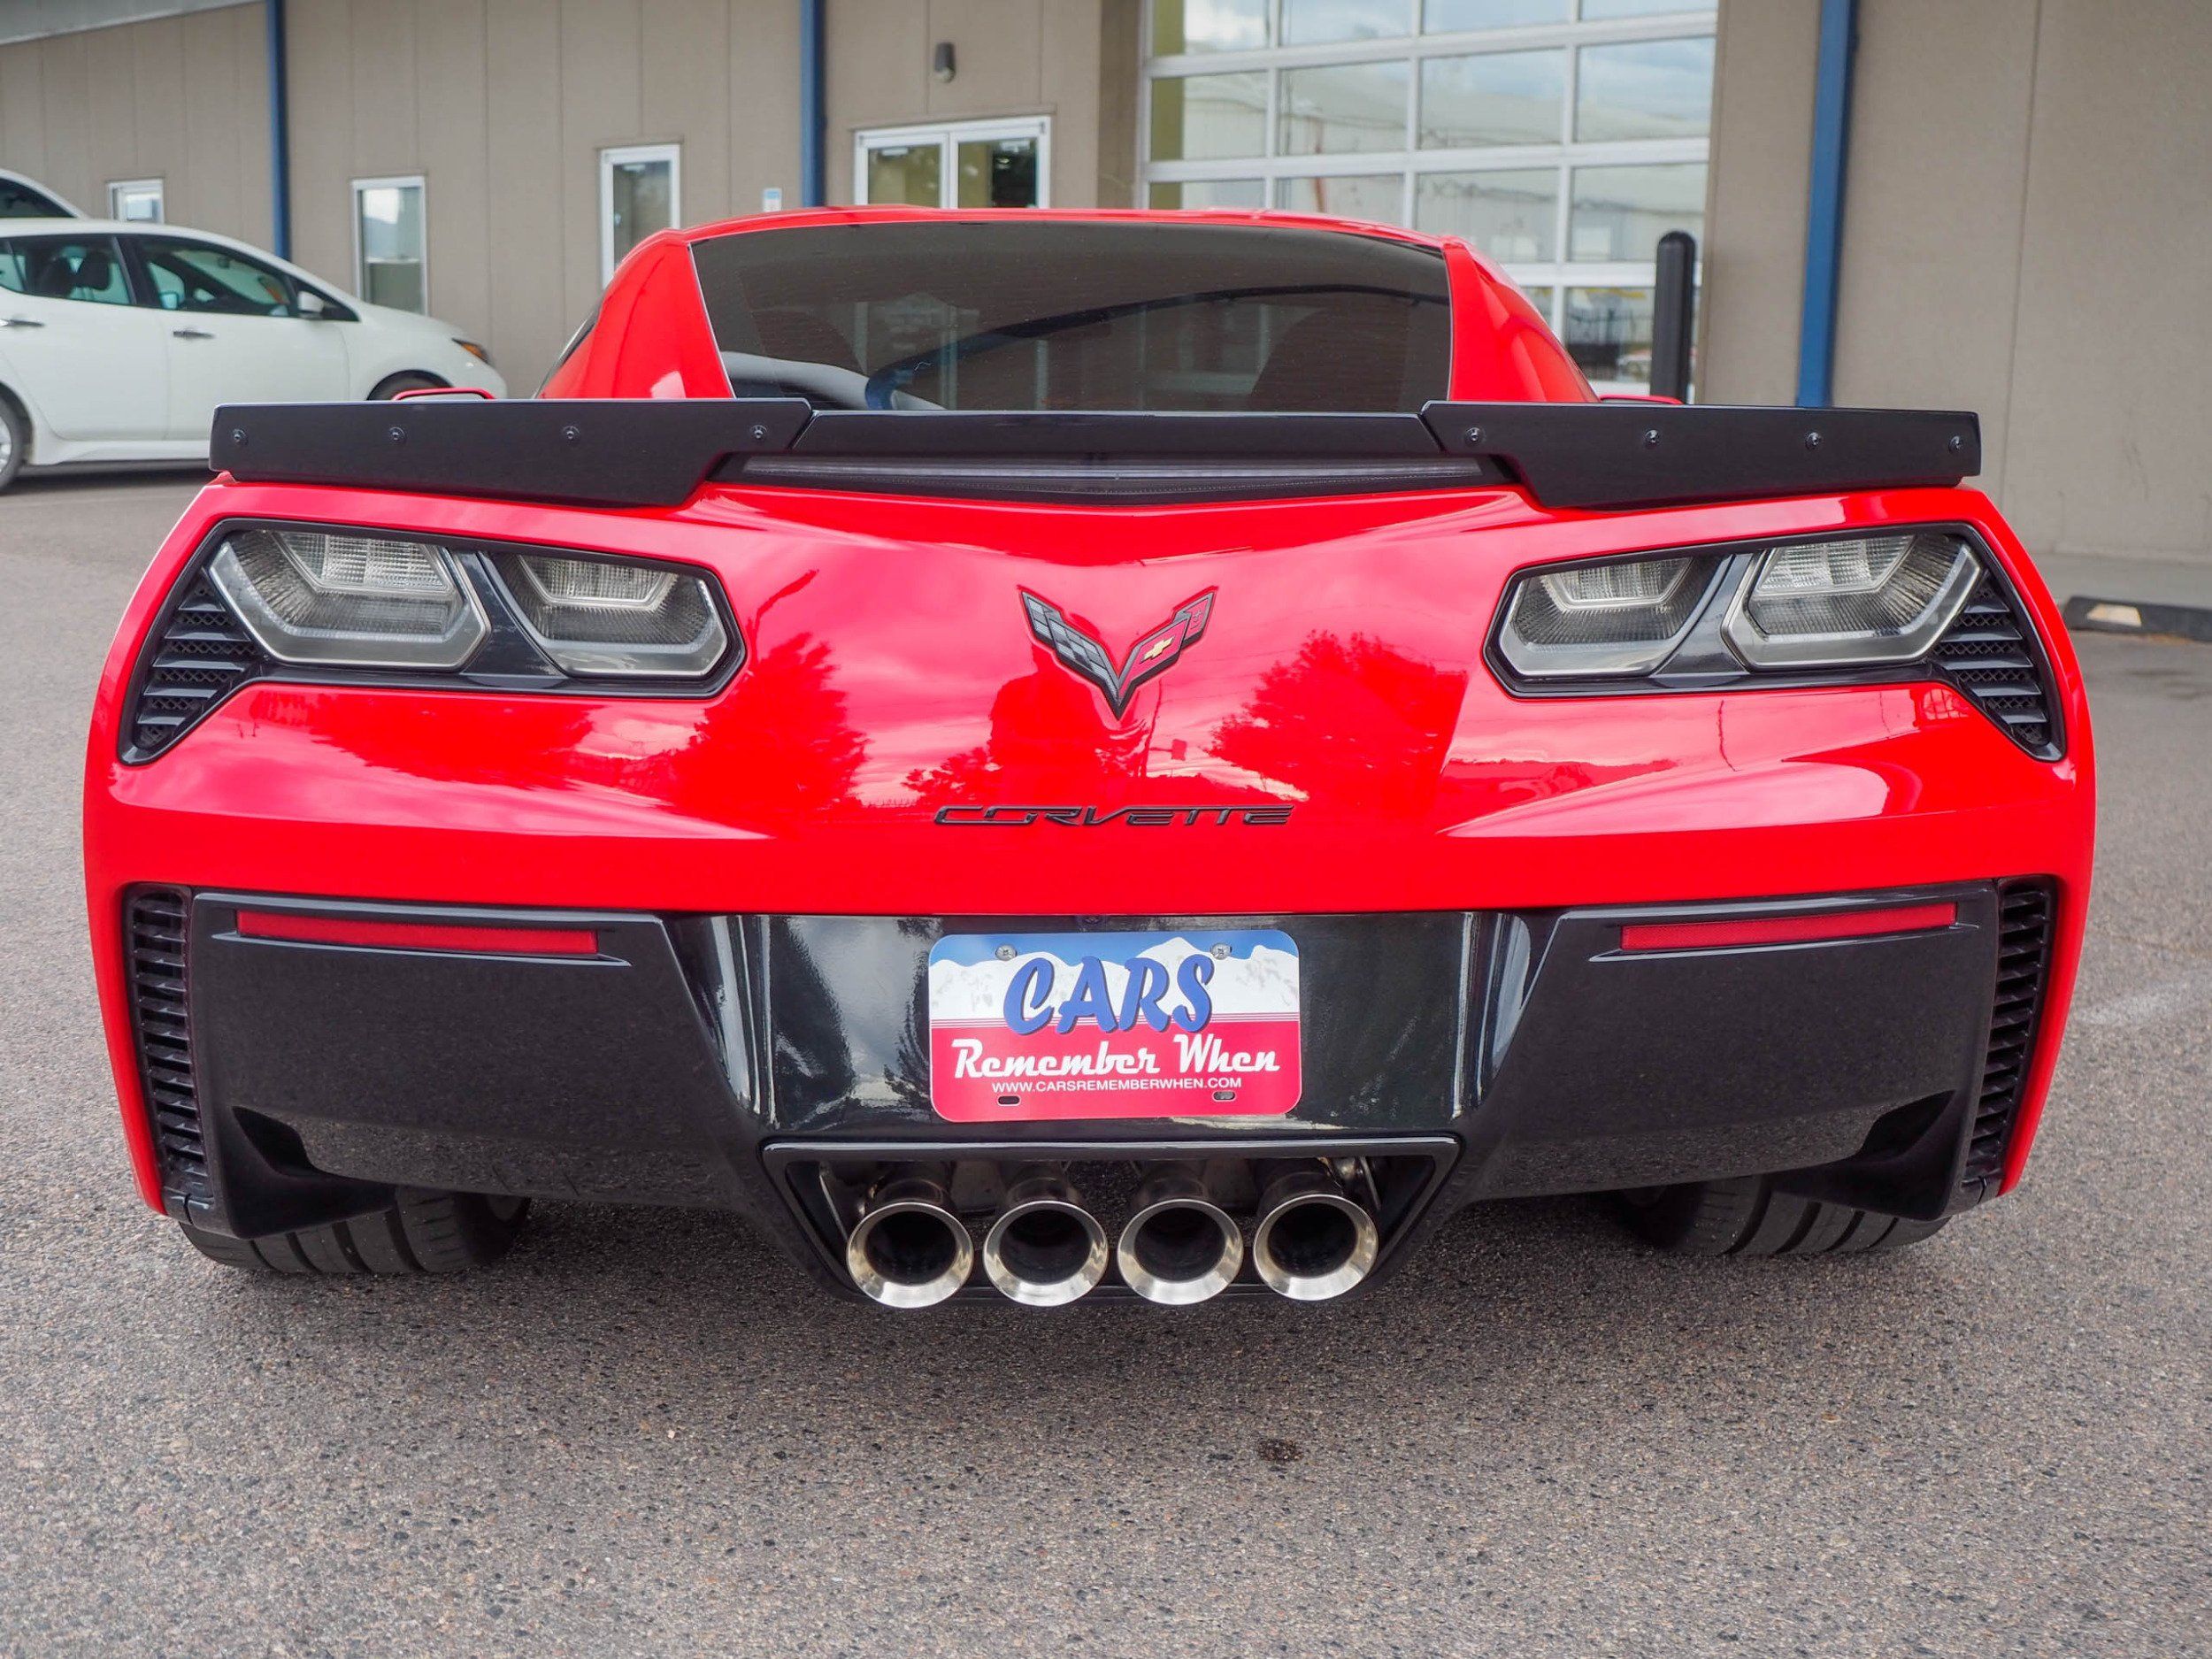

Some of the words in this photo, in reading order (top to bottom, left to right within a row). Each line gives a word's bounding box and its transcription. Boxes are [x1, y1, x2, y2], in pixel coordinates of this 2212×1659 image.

[934, 804, 1294, 826] CORVETTE
[1002, 954, 1216, 1035] CARS
[951, 1038, 1160, 1079] Remember
[1172, 1033, 1281, 1073] When
[992, 1077, 1242, 1093] WWW.CARSREMEMBERWHEN.COM
